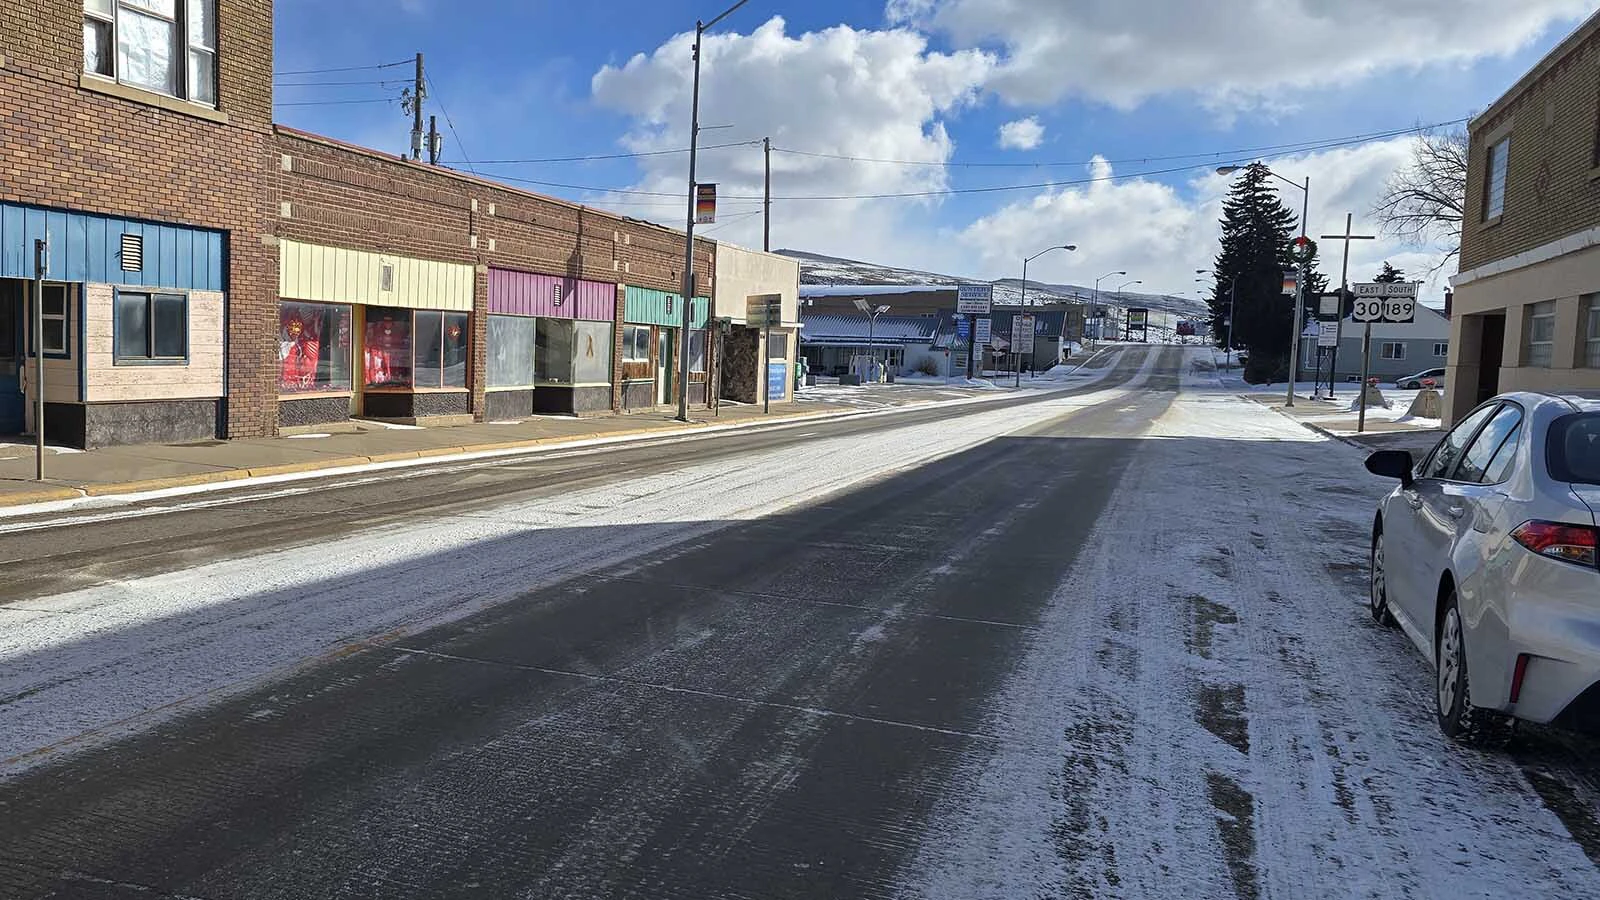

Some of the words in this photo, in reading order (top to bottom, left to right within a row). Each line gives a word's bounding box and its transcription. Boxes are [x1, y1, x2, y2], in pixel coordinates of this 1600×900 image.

[1360, 286, 1379, 294] EAST
[1387, 285, 1412, 294] SOUTH
[1355, 302, 1379, 316] 30
[1386, 303, 1412, 315] 189
